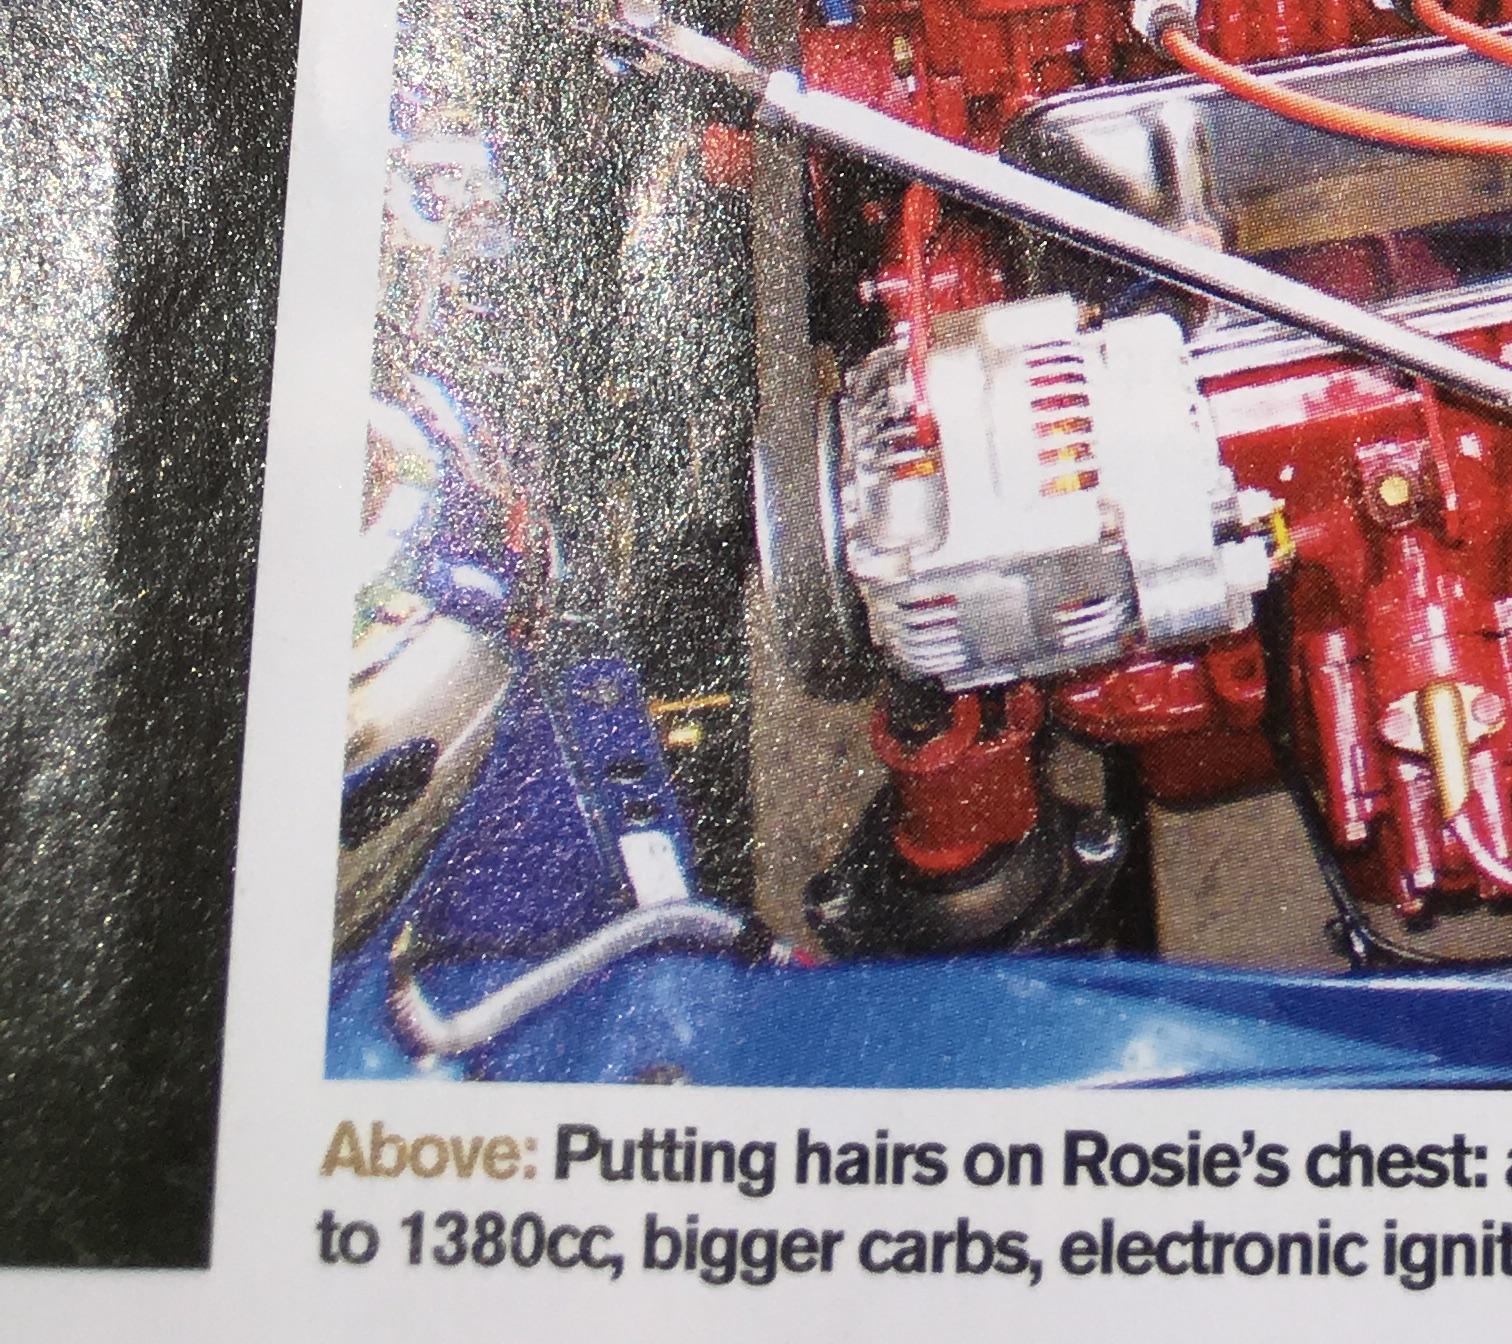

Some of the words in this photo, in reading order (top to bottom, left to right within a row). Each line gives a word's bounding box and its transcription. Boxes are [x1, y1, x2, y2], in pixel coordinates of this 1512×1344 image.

[320, 1120, 537, 1180] Above:
[554, 1123, 777, 1199] Putting
[796, 1128, 949, 1187] hairs
[963, 1141, 1043, 1187] on
[1304, 1130, 1488, 1189] chest:
[315, 1209, 379, 1266] to
[400, 1210, 625, 1281] 1380cc,
[642, 1213, 845, 1287] bigger
[857, 1217, 1043, 1287] carbs,
[1060, 1217, 1369, 1278] electronic
